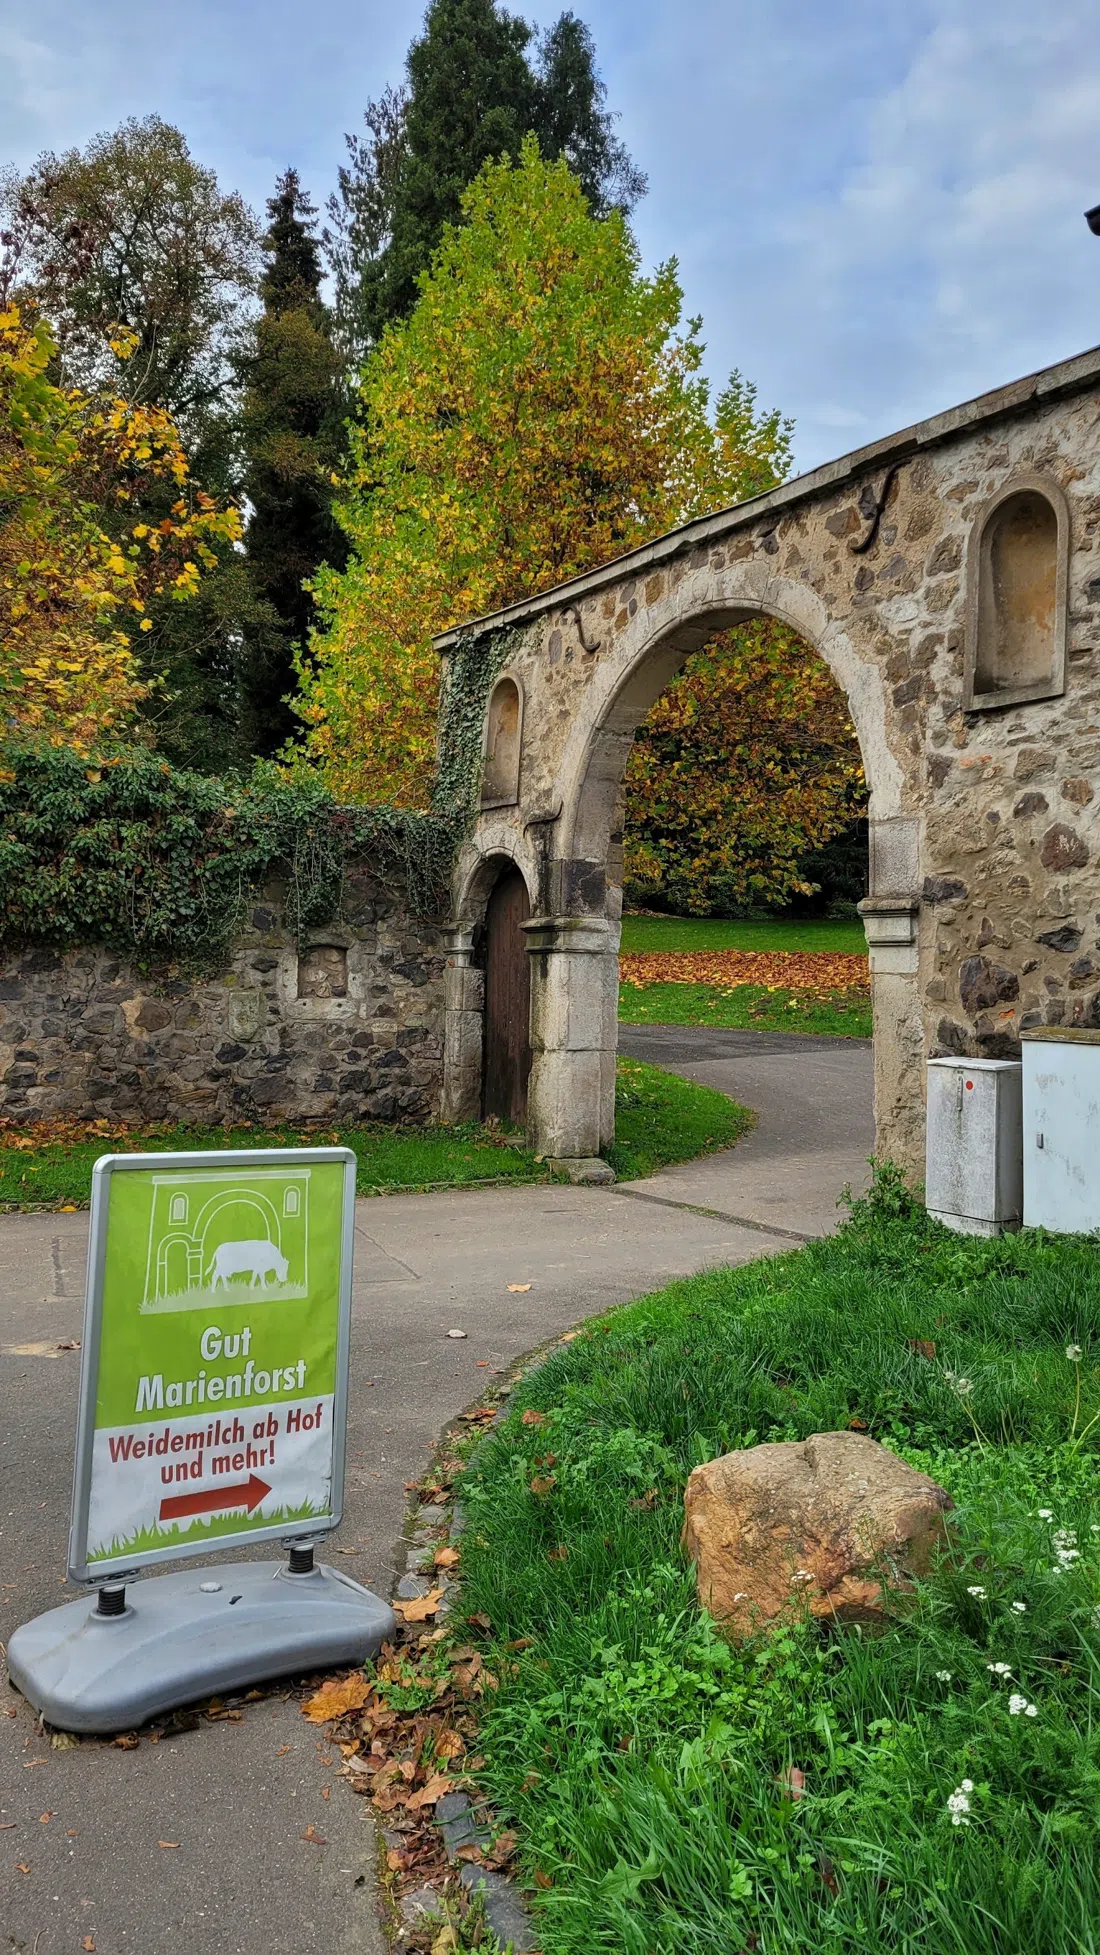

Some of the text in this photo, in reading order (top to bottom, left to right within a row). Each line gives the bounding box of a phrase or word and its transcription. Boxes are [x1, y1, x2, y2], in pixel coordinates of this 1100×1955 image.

[200, 1326, 252, 1361] Gut
[134, 1359, 307, 1412] Marienforst
[108, 1403, 323, 1463] Weidemilch ab Hof
[160, 1439, 276, 1485] und mehr!
